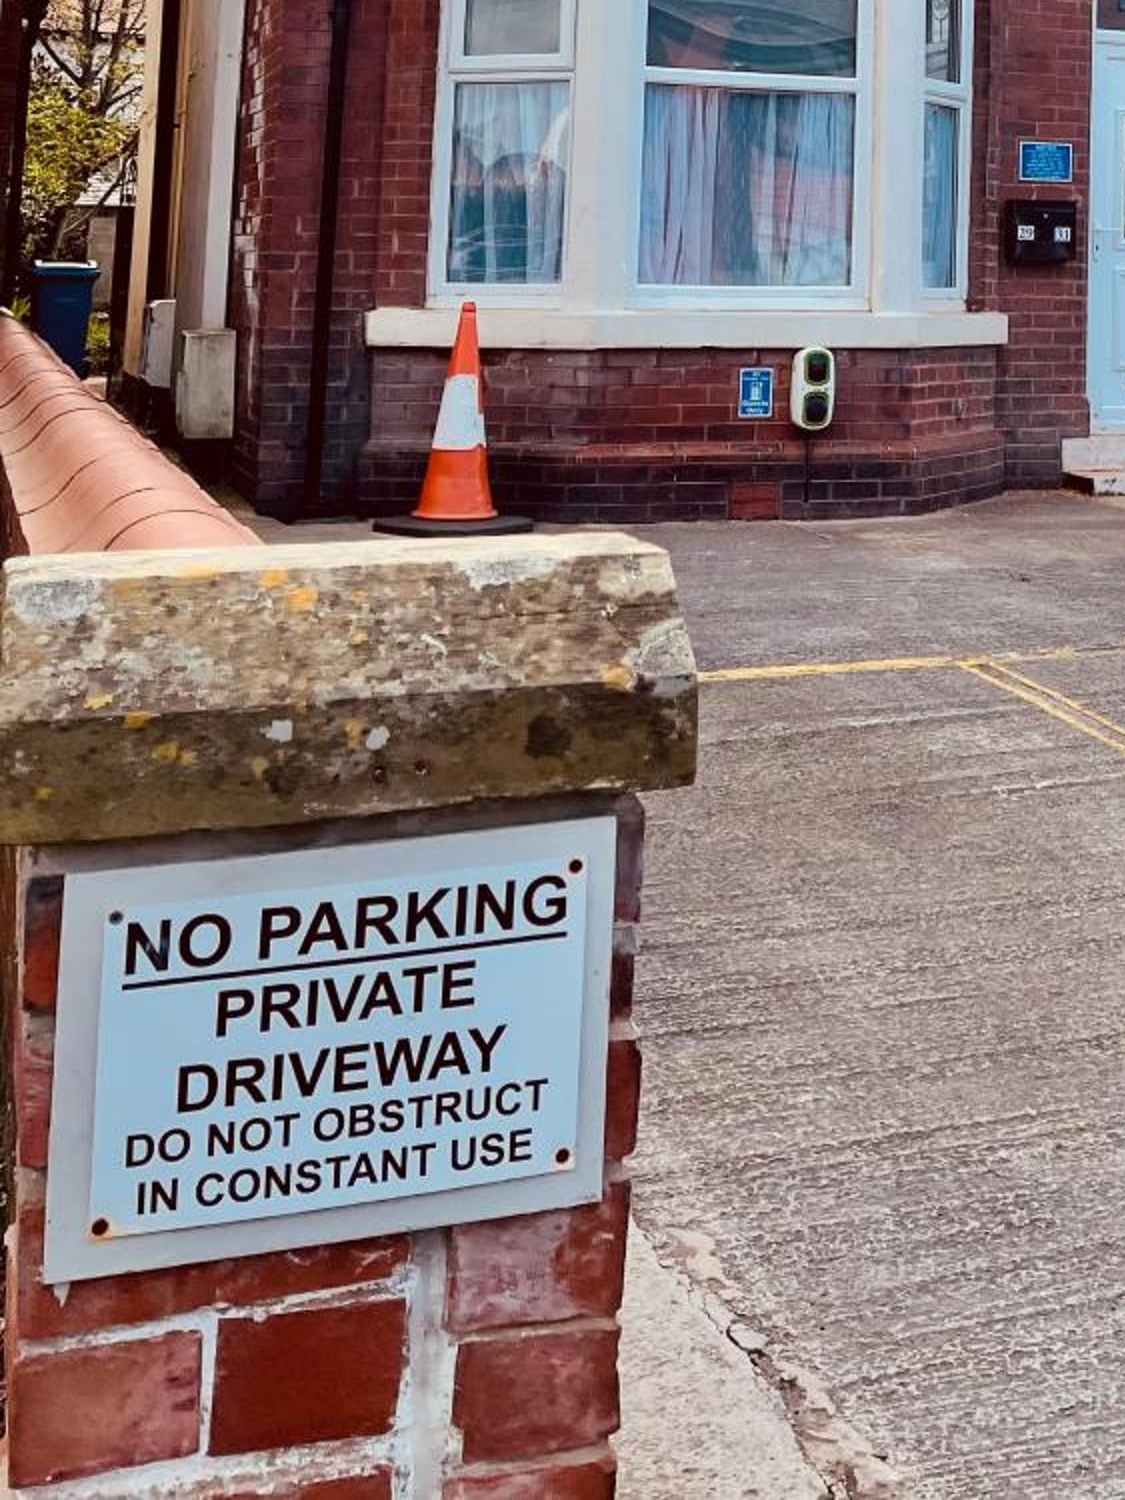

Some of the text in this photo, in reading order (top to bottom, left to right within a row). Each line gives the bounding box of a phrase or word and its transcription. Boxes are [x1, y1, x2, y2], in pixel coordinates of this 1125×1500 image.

[1019, 227, 1033, 239] 29
[124, 874, 569, 975] NO PARKING
[215, 960, 477, 1037] PRIVATE
[175, 1024, 508, 1113] DRIVEWAY
[125, 1078, 549, 1168] DO NOT OBSTRUCT
[136, 1128, 533, 1215] IN CONSTANT USE
